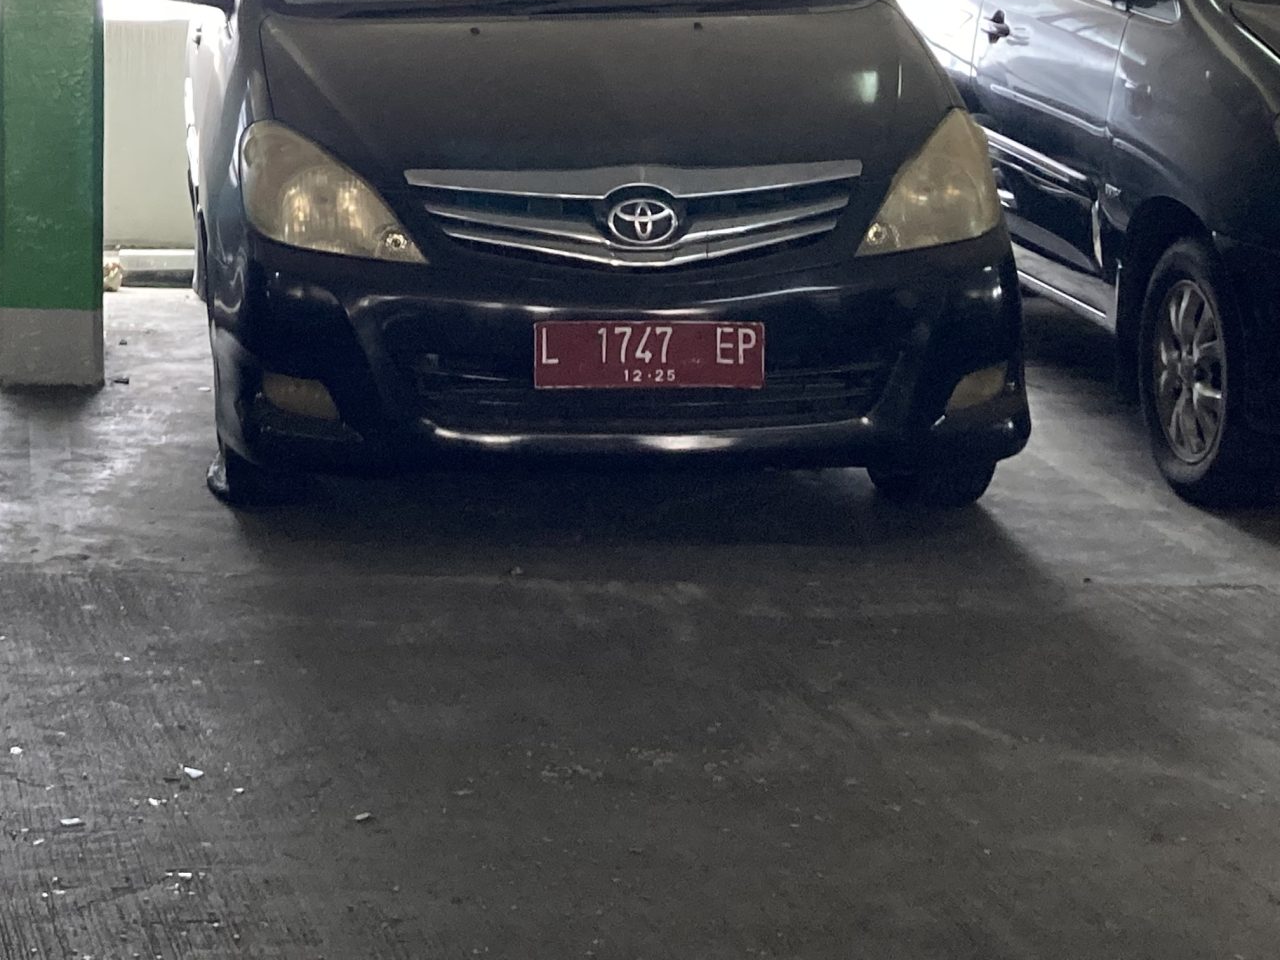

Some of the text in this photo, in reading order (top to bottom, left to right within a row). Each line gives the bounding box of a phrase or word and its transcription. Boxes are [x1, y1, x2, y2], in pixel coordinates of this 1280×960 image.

[541, 326, 757, 365] L 1747 EP
